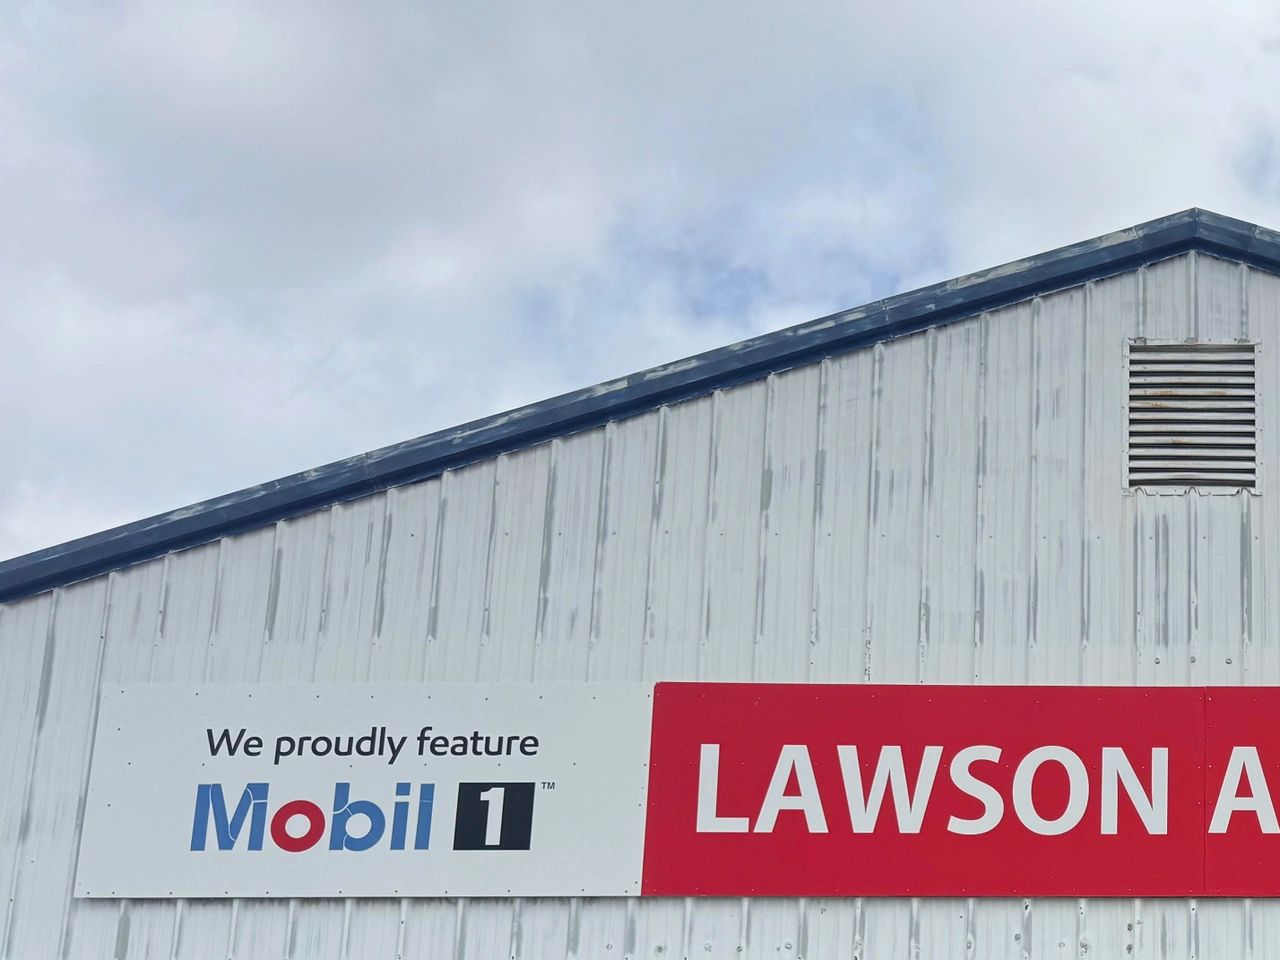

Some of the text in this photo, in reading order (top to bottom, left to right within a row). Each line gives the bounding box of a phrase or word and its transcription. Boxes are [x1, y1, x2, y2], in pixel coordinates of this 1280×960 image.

[206, 726, 539, 765] We proudly feature
[190, 782, 435, 852] Mobil
[696, 743, 1169, 836] LAWSON
